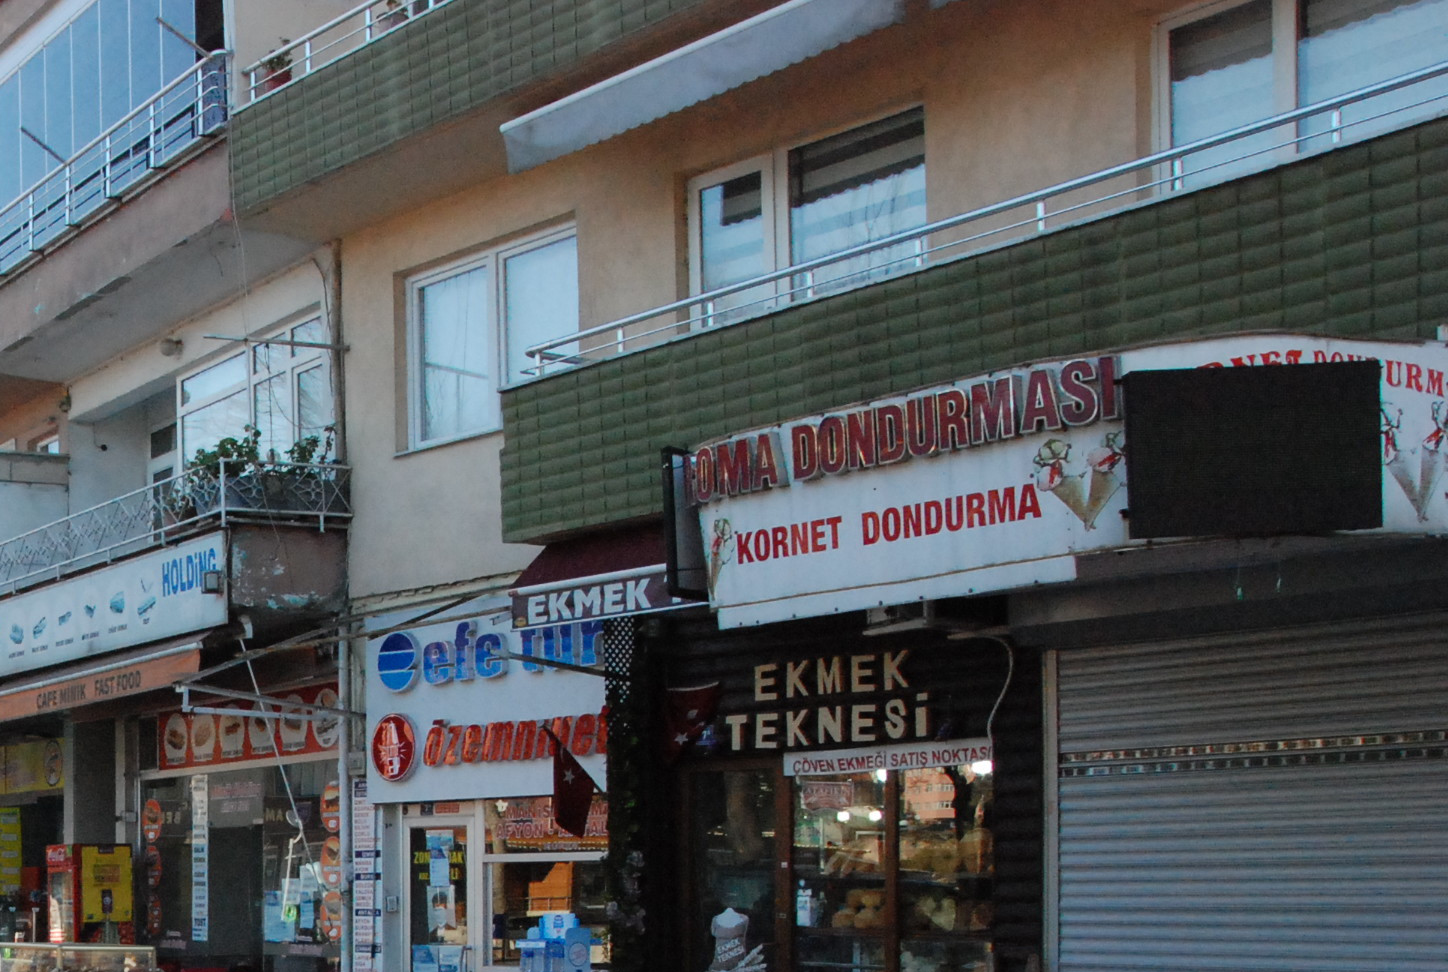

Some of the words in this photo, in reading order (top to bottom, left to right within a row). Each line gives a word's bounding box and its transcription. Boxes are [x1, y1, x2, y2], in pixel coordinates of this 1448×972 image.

[791, 356, 1118, 481] DONDURMASI
[736, 516, 842, 566] KORNET
[862, 483, 1042, 546] DONDURMA
[527, 579, 650, 625] EKMEK
[422, 621, 507, 686] efe
[754, 650, 909, 701] EKMEK
[36, 691, 57, 710] CAFE
[94, 675, 114, 697] FAST
[116, 670, 141, 691] FOOD
[725, 692, 929, 750] TEKNESİ
[793, 756, 835, 775] ÇÖVEN
[838, 751, 887, 772] EKMEĞİ
[891, 751, 929, 769] SATIŞ
